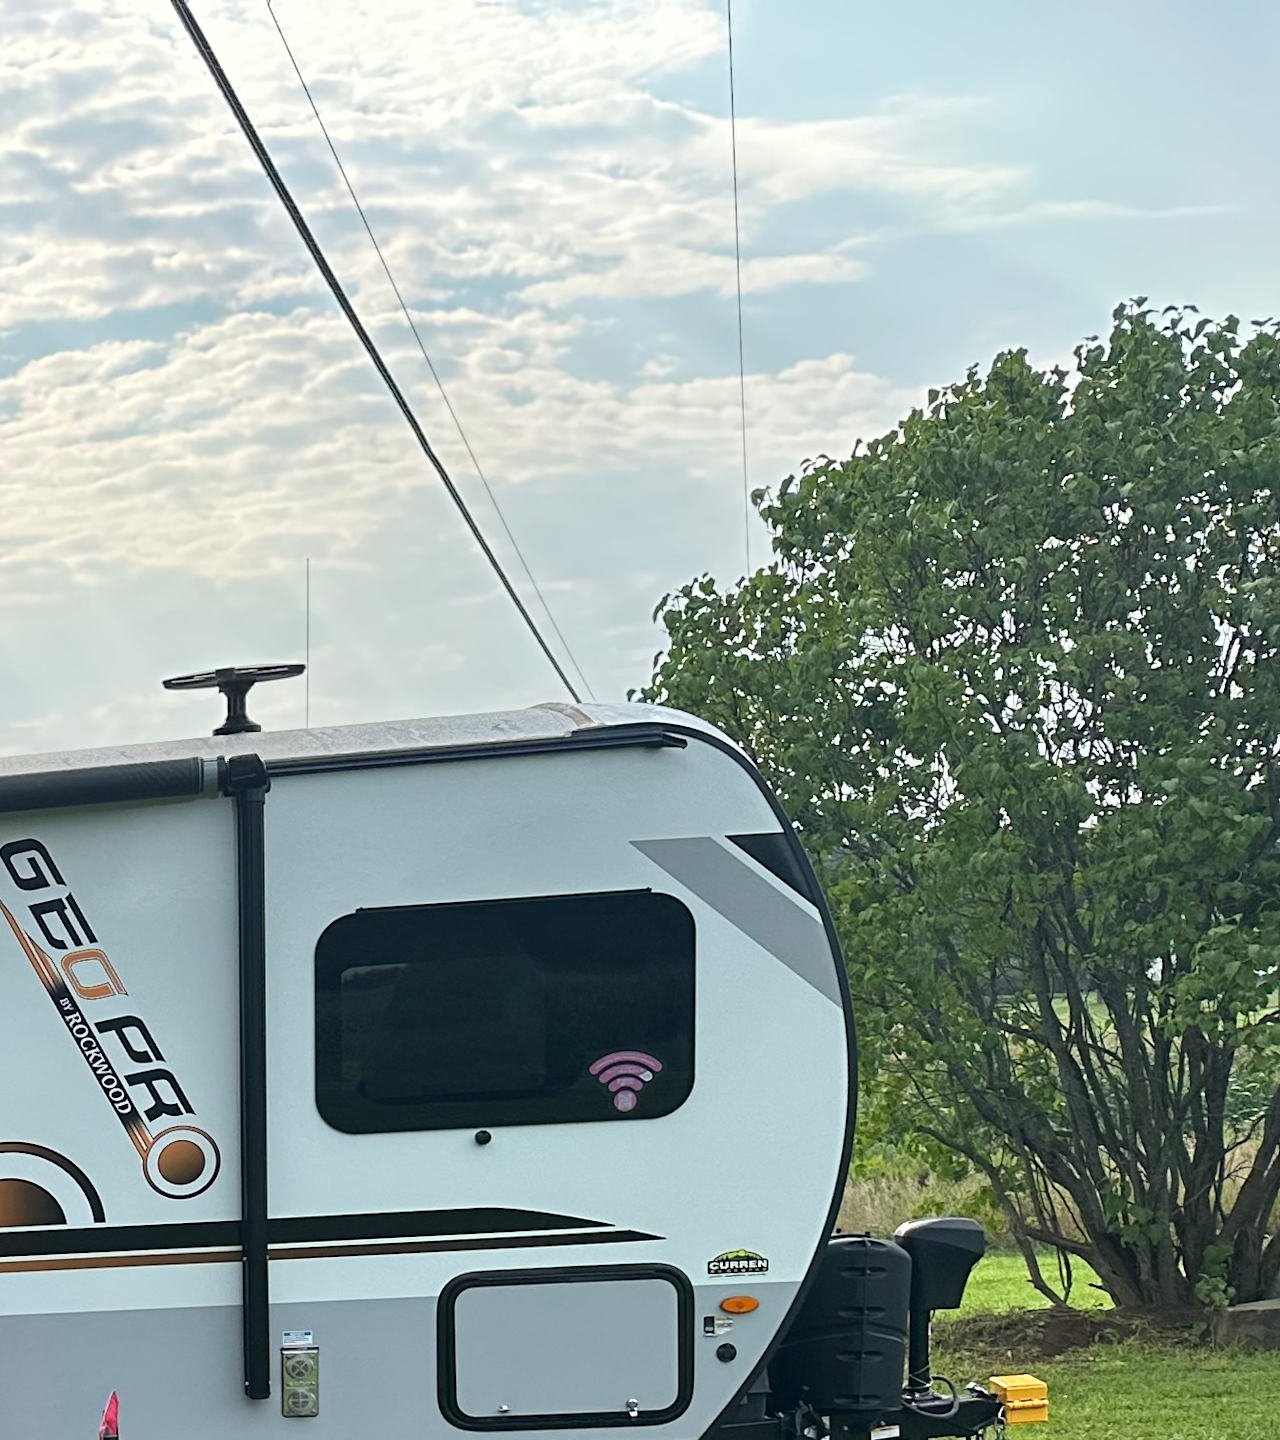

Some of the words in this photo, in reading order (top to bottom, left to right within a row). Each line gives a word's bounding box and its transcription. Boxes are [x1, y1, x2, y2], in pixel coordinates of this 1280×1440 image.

[0, 838, 128, 1000] GEO
[59, 997, 75, 1012] BY
[64, 1011, 133, 1114] ROCKWOOD
[708, 1259, 768, 1270] CURREN
